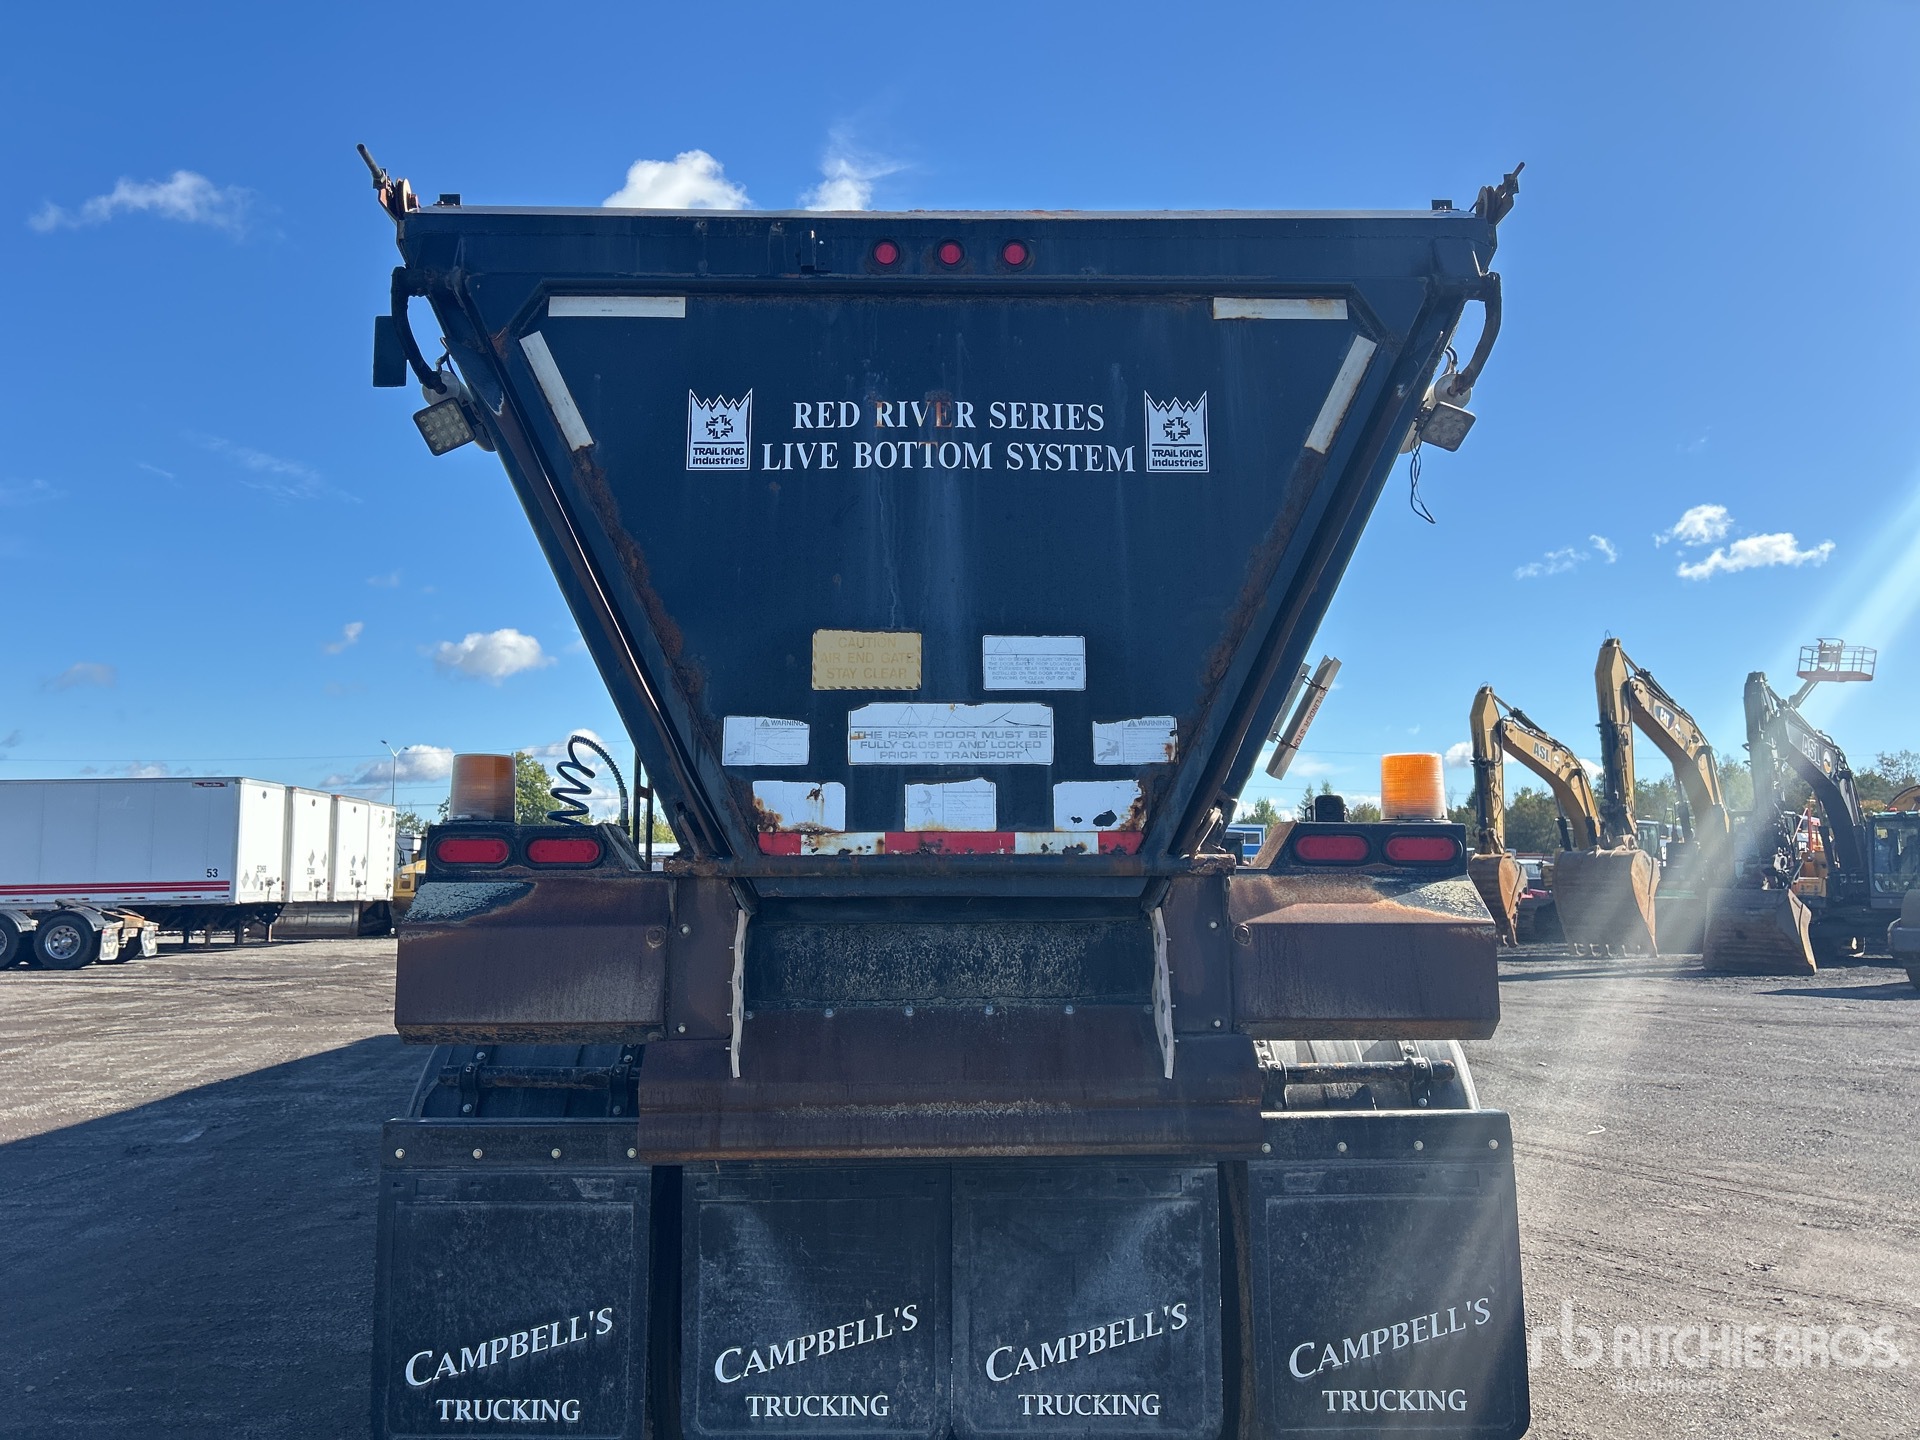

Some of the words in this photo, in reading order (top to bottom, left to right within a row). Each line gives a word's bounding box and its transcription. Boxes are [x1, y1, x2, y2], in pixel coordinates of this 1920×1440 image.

[793, 401, 861, 429] RED
[874, 400, 976, 428] RIVER
[989, 401, 1105, 432] SERIES
[692, 456, 745, 465] industries
[761, 441, 839, 471] LIVE
[852, 441, 993, 470] BOTTOM
[1006, 442, 1136, 473] SYSTEM
[1152, 458, 1204, 467] industries
[838, 636, 897, 648] CAUTION
[820, 652, 840, 663] AIR
[847, 652, 874, 663] END
[880, 652, 915, 664] GATE
[826, 667, 857, 679] STAY
[863, 667, 907, 679] CLEAR
[1304, 690, 1326, 728] CYLINDER
[771, 719, 804, 727] WARNING
[1137, 719, 1171, 727] WARNING
[854, 730, 882, 739] THE
[888, 730, 929, 739] REAR
[934, 730, 977, 739] DOOR
[981, 730, 1023, 739] MUST
[1028, 730, 1048, 739] BE
[860, 741, 897, 749] FULLY
[902, 740, 953, 749] CLOSED
[958, 740, 987, 749] AND
[990, 740, 1042, 749] LOCKED
[879, 751, 918, 759] PRIOR
[922, 751, 940, 759] TO
[944, 751, 1023, 759] TRANSPORT
[1532, 742, 1550, 763] ASL
[206, 868, 218, 878] 53
[404, 1307, 613, 1386] CAMPBELL'S
[714, 1304, 918, 1384] CAMPBELL'S
[985, 1303, 1188, 1382] CAMPBELL'S
[1288, 1297, 1491, 1379] CAMPBELL'S
[436, 1399, 581, 1421] TRUCKING
[745, 1394, 889, 1417] TRUCKING
[1018, 1394, 1161, 1416] TRUCKING
[1322, 1389, 1468, 1412] TRUCKING
